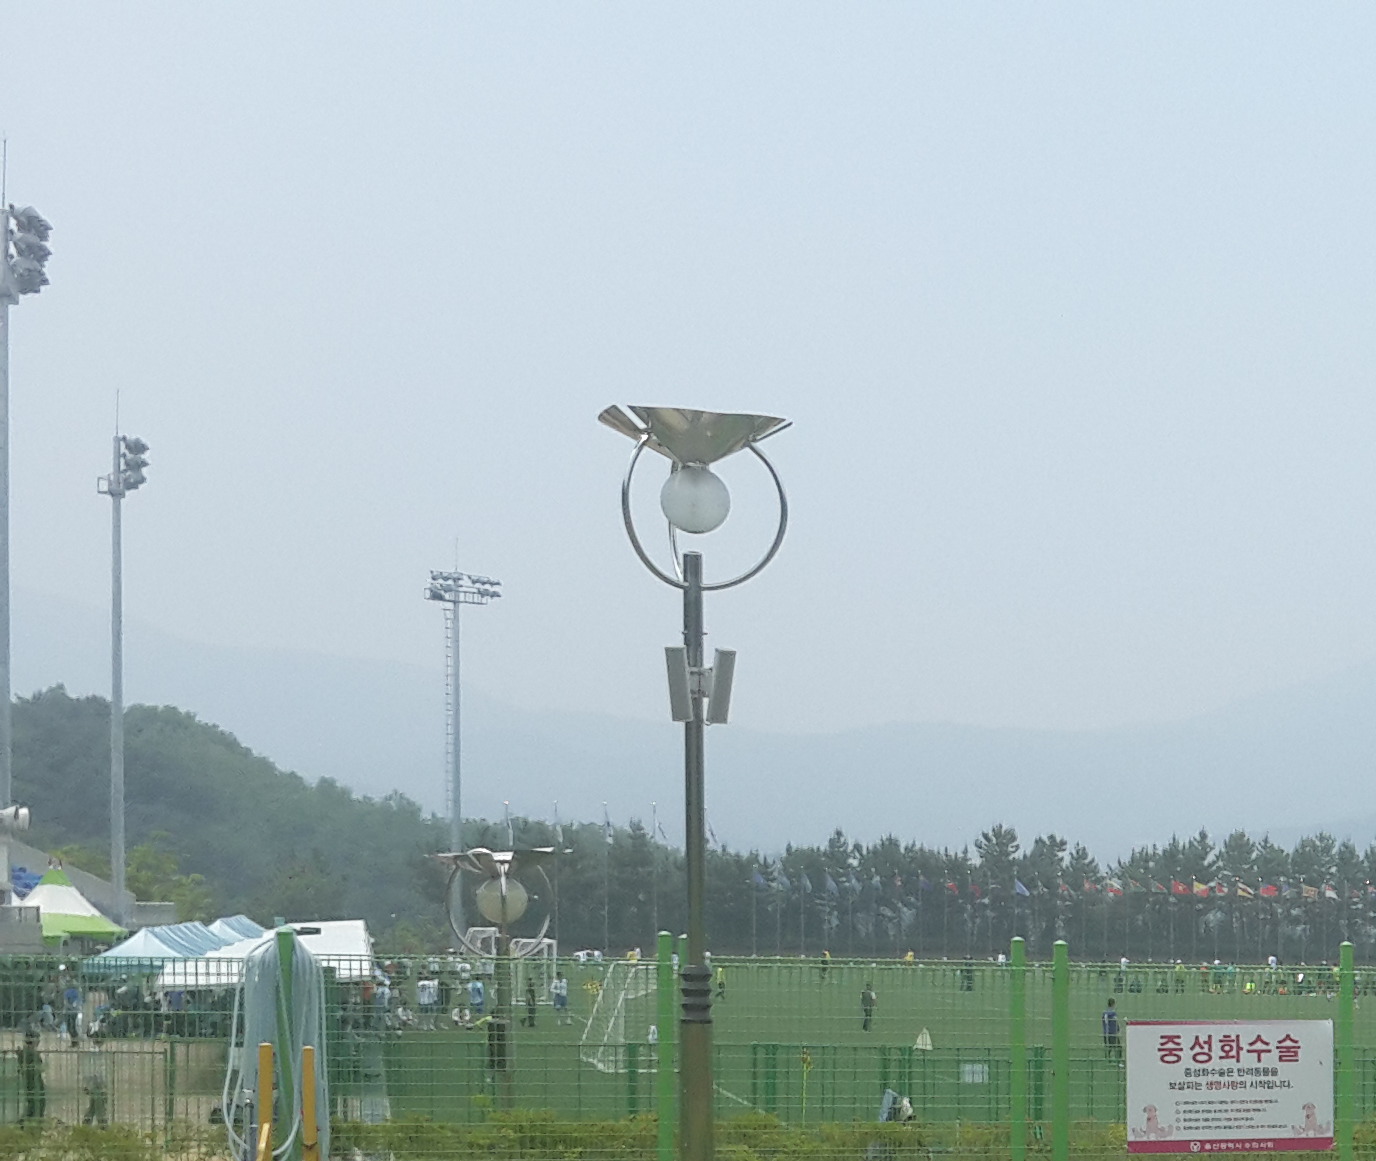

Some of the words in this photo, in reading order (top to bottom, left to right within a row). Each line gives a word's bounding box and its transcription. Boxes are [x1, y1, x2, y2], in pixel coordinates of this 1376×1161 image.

[1157, 1033, 1301, 1064] 중성화수술
[1184, 1067, 1235, 1078] 중성화수술은
[1237, 1067, 1279, 1077] 반려동물을
[1169, 1081, 1202, 1091] 보살피는
[1205, 1081, 1247, 1090] 생명사랑의
